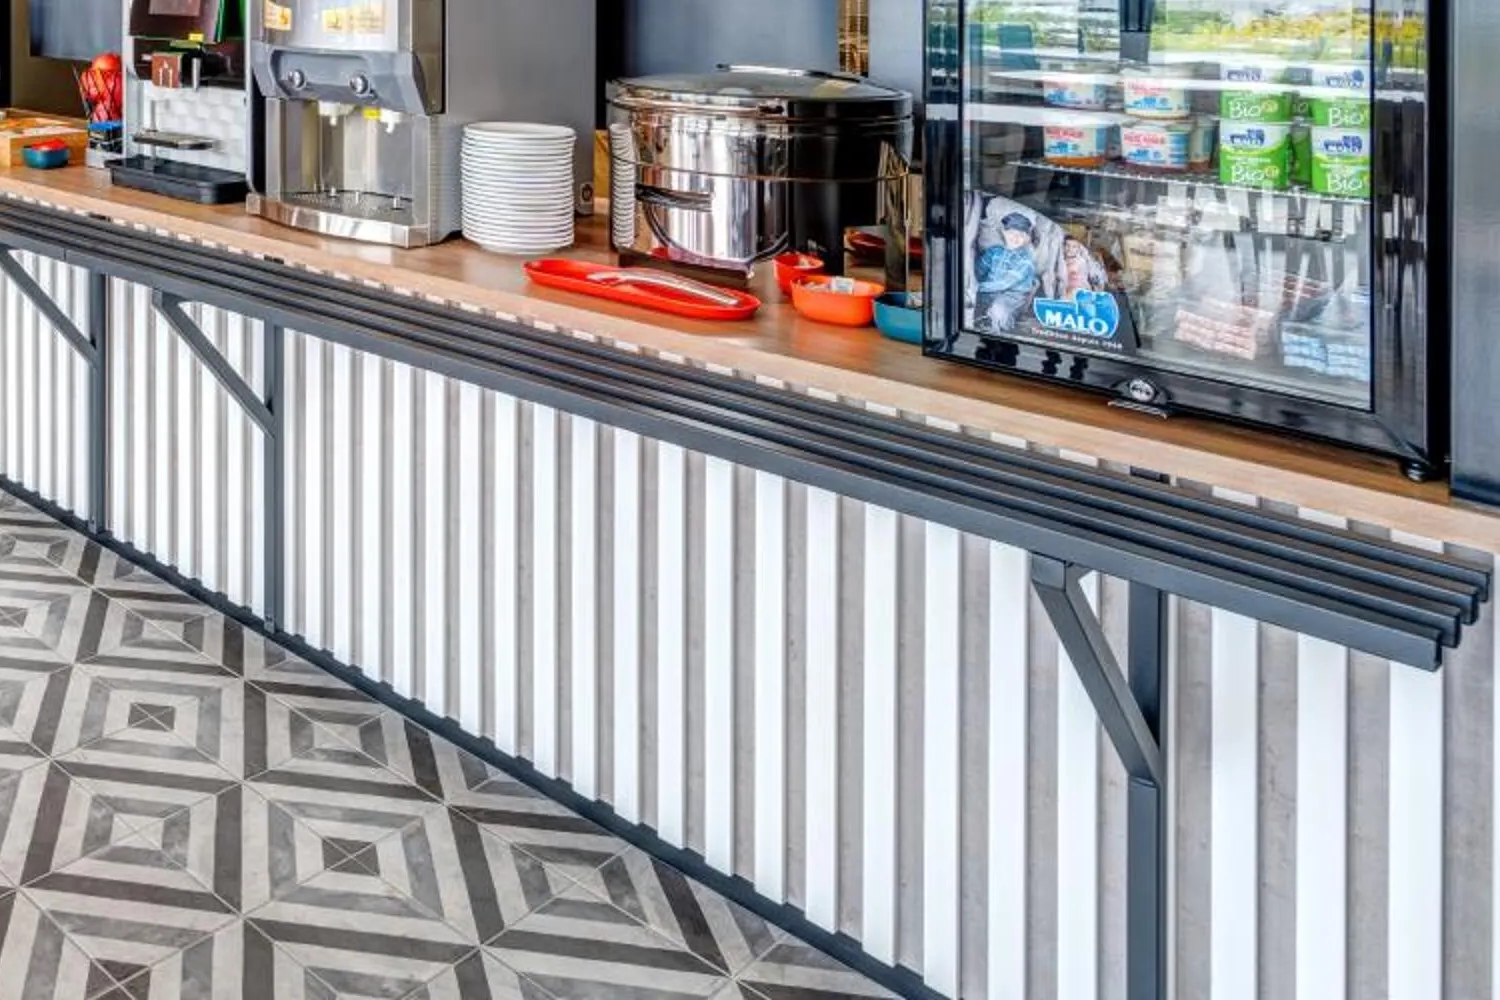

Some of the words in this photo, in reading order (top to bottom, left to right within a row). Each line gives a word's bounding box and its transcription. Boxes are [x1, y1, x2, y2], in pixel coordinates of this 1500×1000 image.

[1228, 98, 1262, 119] Bio
[1328, 106, 1363, 128] Bio
[1230, 165, 1265, 184] Bio
[1327, 172, 1363, 193] Bio
[1044, 309, 1109, 336] MALO
